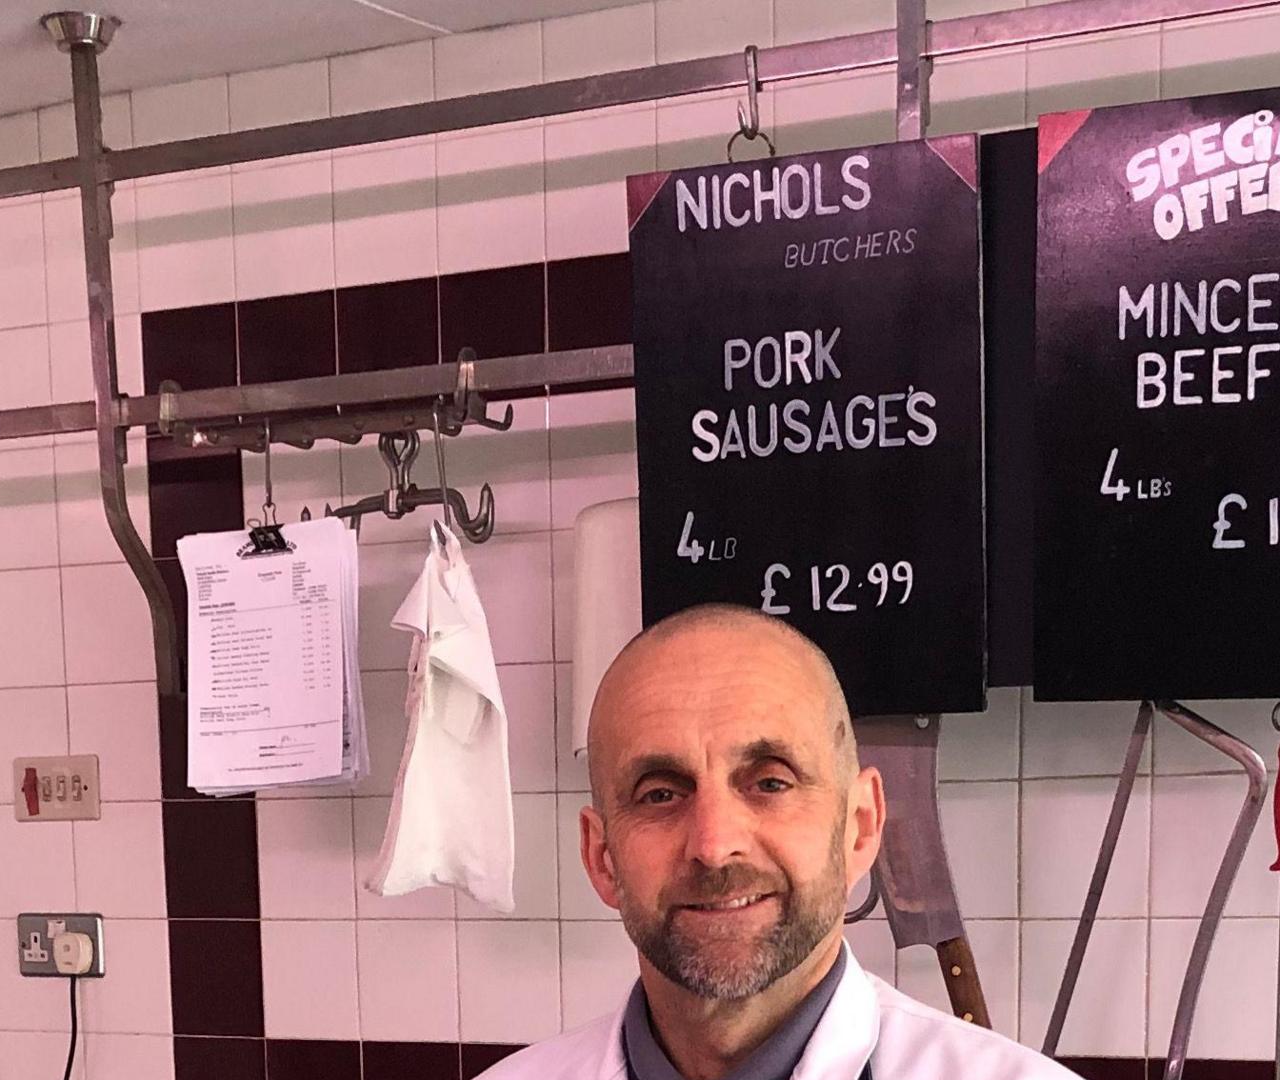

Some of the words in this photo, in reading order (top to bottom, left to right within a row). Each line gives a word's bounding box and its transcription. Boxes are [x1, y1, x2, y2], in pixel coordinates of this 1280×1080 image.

[676, 154, 872, 232] NICHOLS
[783, 228, 918, 269] BUTCHERS
[724, 327, 842, 392] PORK
[1137, 343, 1280, 409] BEEF
